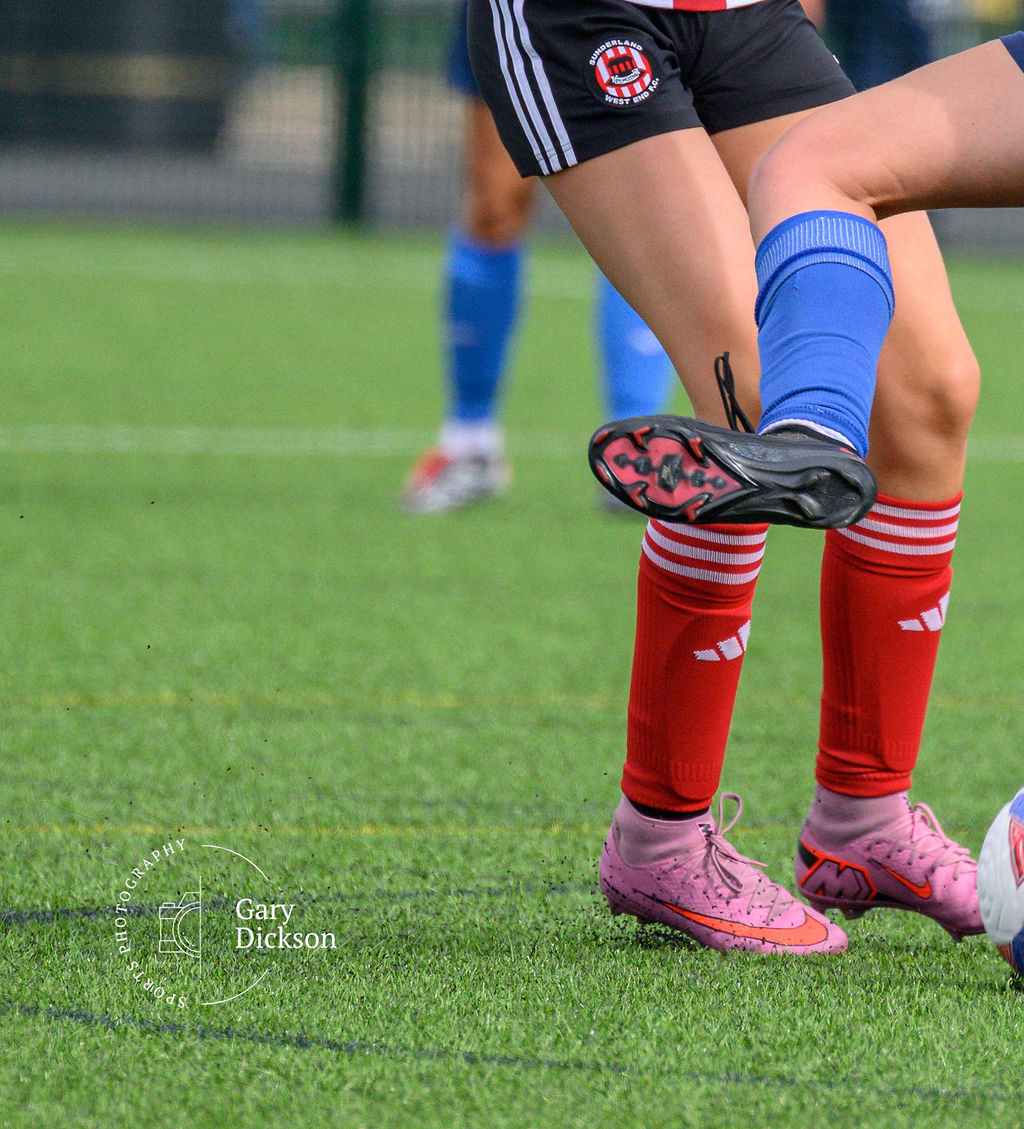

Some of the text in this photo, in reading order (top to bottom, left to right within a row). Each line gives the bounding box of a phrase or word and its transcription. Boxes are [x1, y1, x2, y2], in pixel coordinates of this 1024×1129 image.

[589, 40, 643, 66] SUNDERLAND
[605, 94, 630, 105] WEST
[633, 91, 649, 103] END
